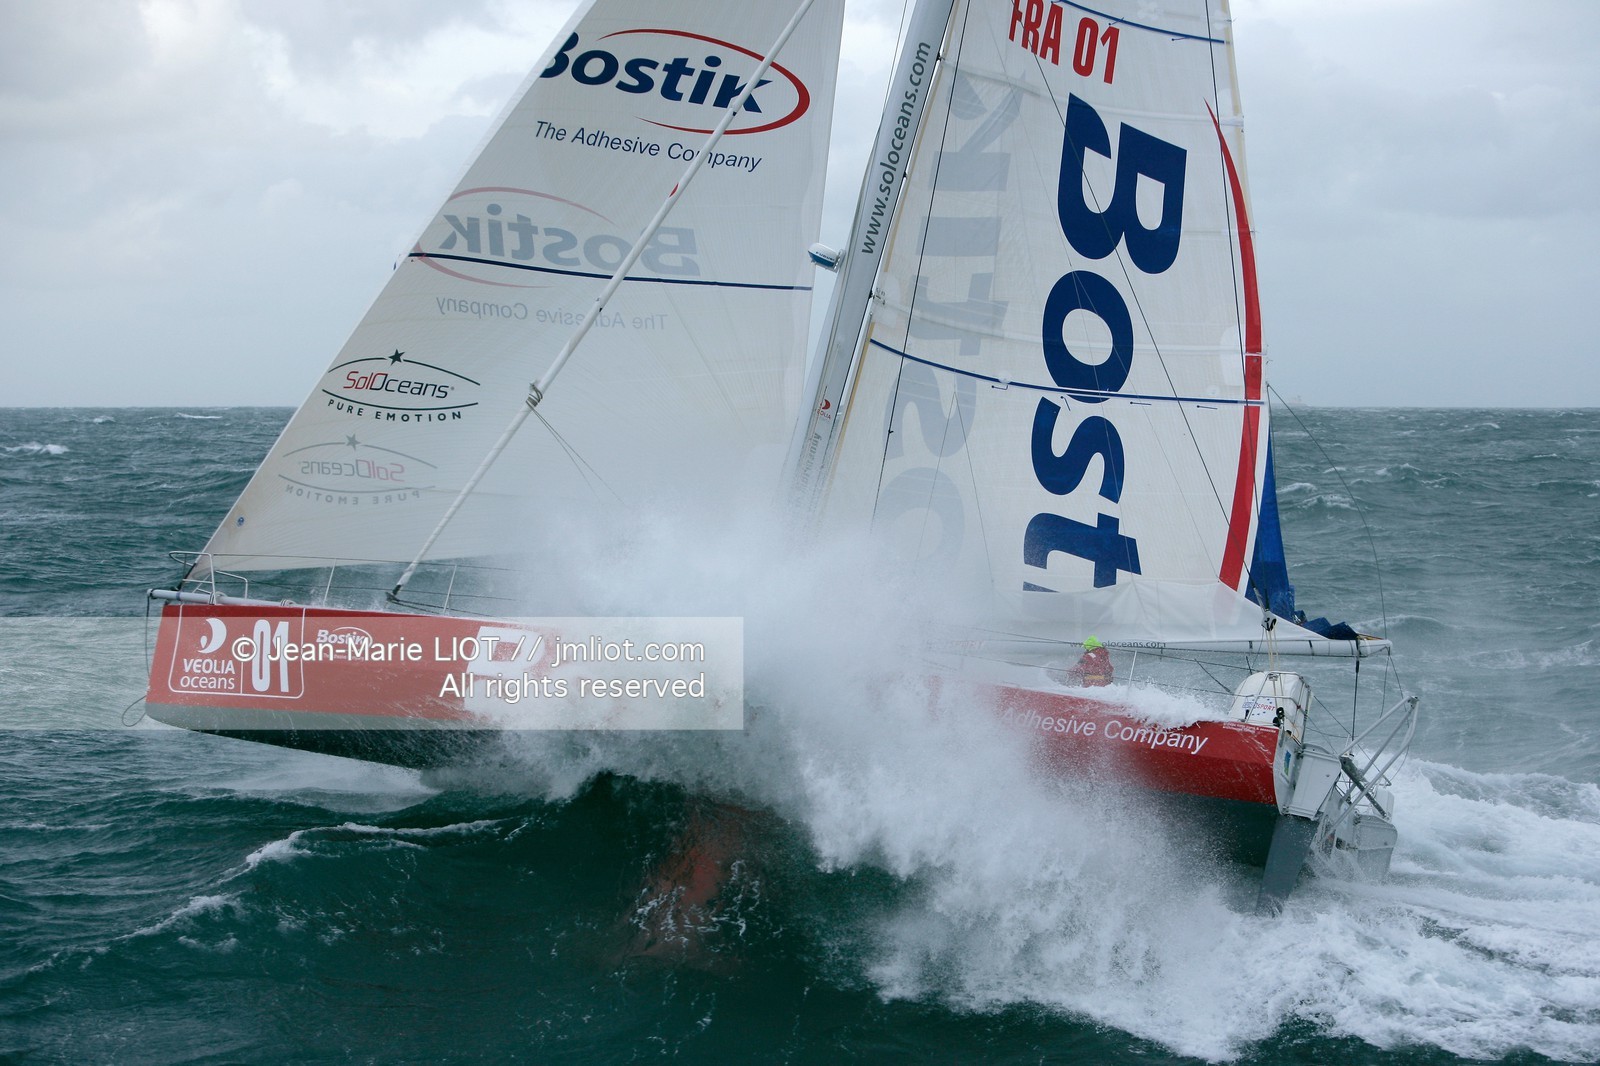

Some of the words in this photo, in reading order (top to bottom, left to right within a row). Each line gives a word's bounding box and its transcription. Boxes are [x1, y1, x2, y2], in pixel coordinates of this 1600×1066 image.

[1009, 0, 1063, 66] FRA
[1073, 17, 1120, 85] 01
[535, 121, 567, 142] The
[571, 127, 660, 156] Adhesive
[862, 41, 931, 254] www.soloceans.com
[1023, 93, 1188, 592] Bost
[343, 371, 450, 398] SolOceans
[327, 399, 364, 417] PURE
[375, 410, 463, 422] EMOTION
[183, 658, 236, 675] VEOLIA
[251, 619, 290, 692] 01
[180, 674, 235, 690] oceans
[1000, 707, 1096, 736] Adhesive
[1104, 720, 1208, 755] Company
